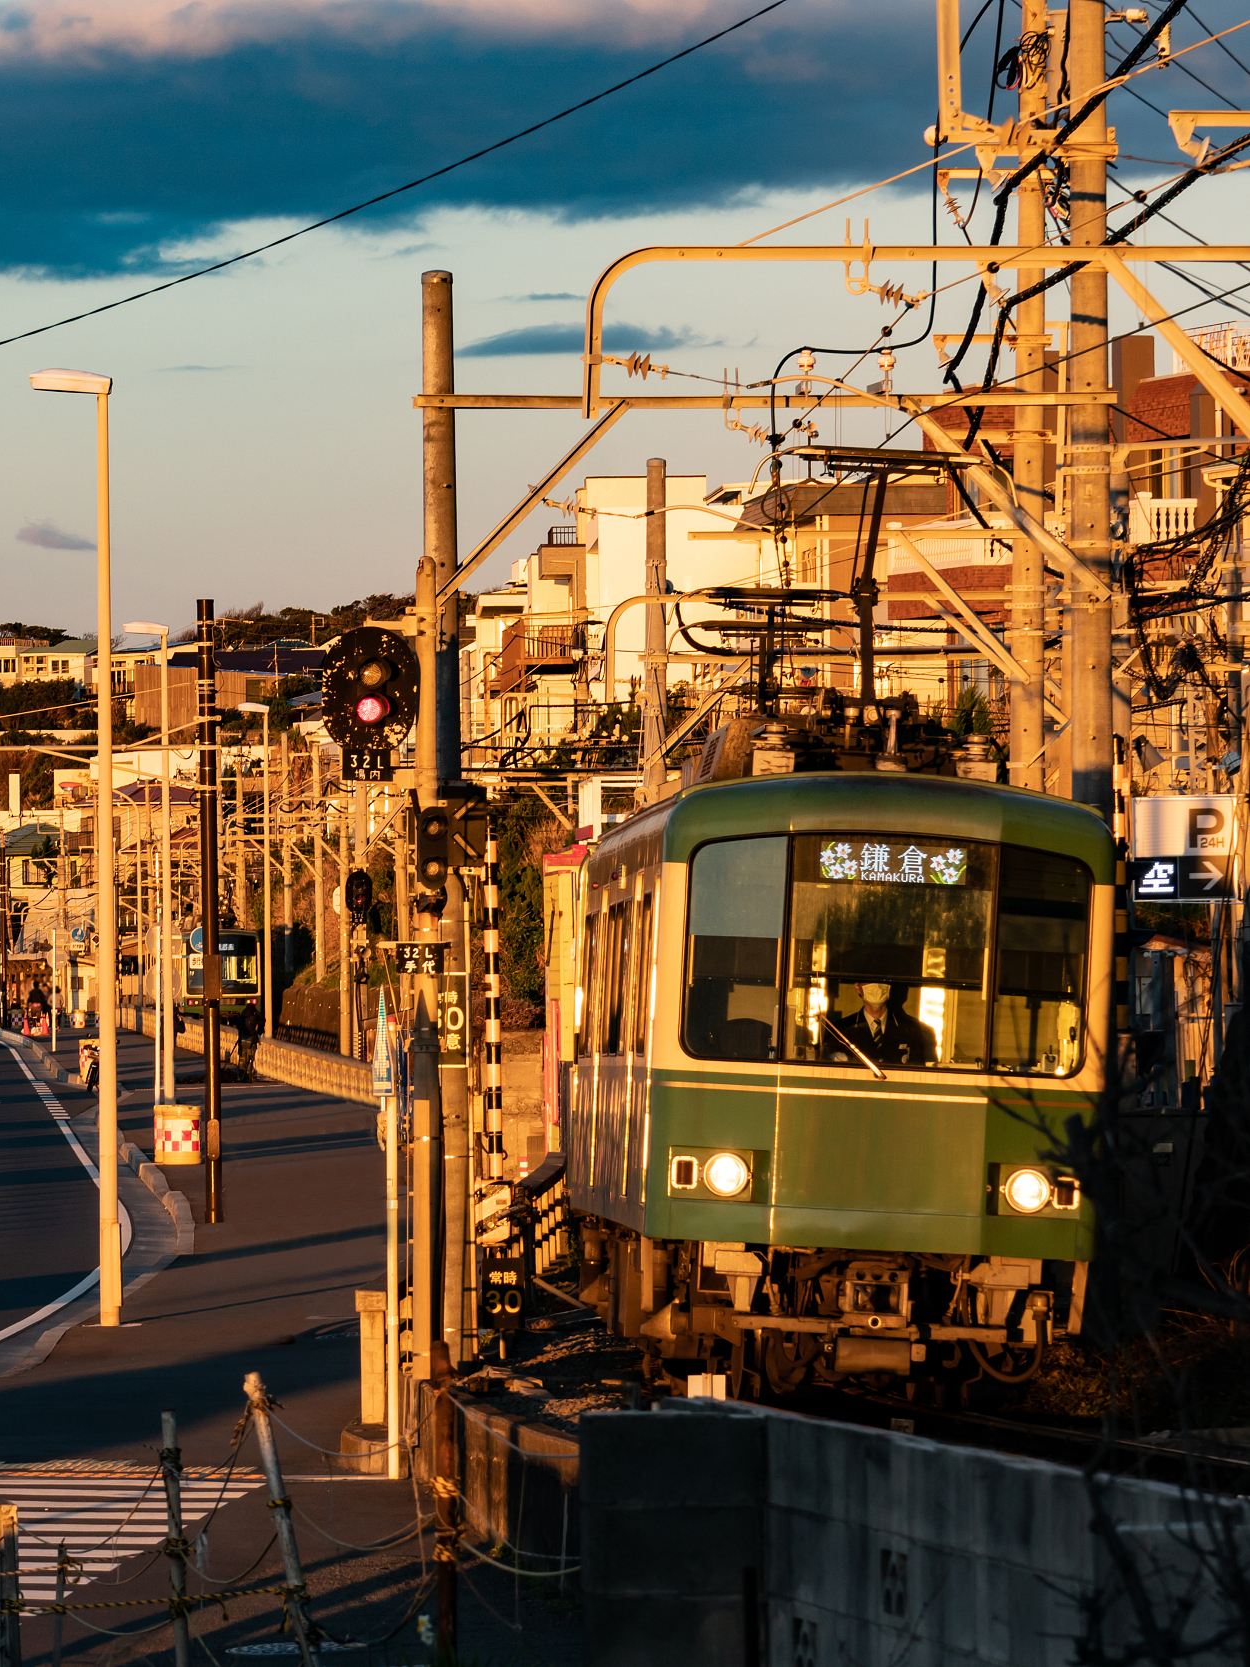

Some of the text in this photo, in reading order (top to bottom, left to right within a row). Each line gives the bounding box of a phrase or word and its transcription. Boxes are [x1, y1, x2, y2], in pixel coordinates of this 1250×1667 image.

[354, 770, 381, 780] 場内
[1188, 808, 1225, 848] P
[1200, 837, 1225, 848] 24H
[859, 843, 928, 874] 鎌倉
[861, 871, 925, 883] KAMAKURA
[1138, 861, 1175, 893] 空
[404, 960, 436, 974] 手代
[488, 1270, 518, 1286] 常時
[485, 1290, 522, 1314] 30
